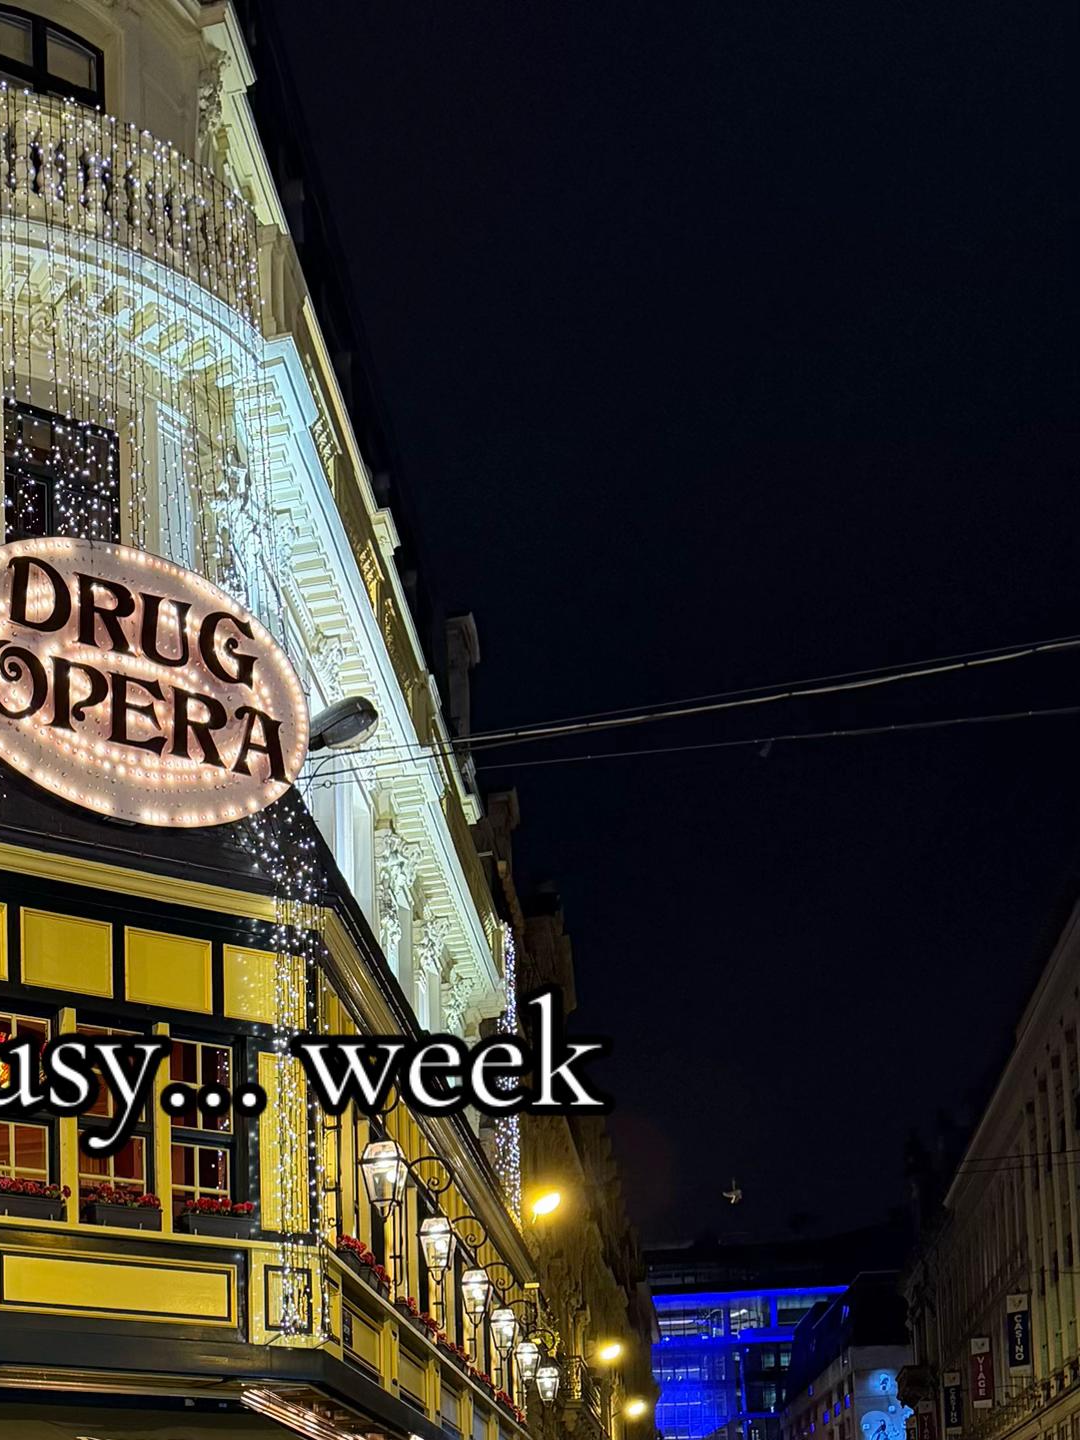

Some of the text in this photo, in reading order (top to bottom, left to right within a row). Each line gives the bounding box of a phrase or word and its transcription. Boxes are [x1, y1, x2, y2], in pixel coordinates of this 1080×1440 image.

[7, 555, 259, 690] DRUG
[1013, 1314, 1025, 1361] CASINO
[976, 1356, 986, 1396] VIAGE
